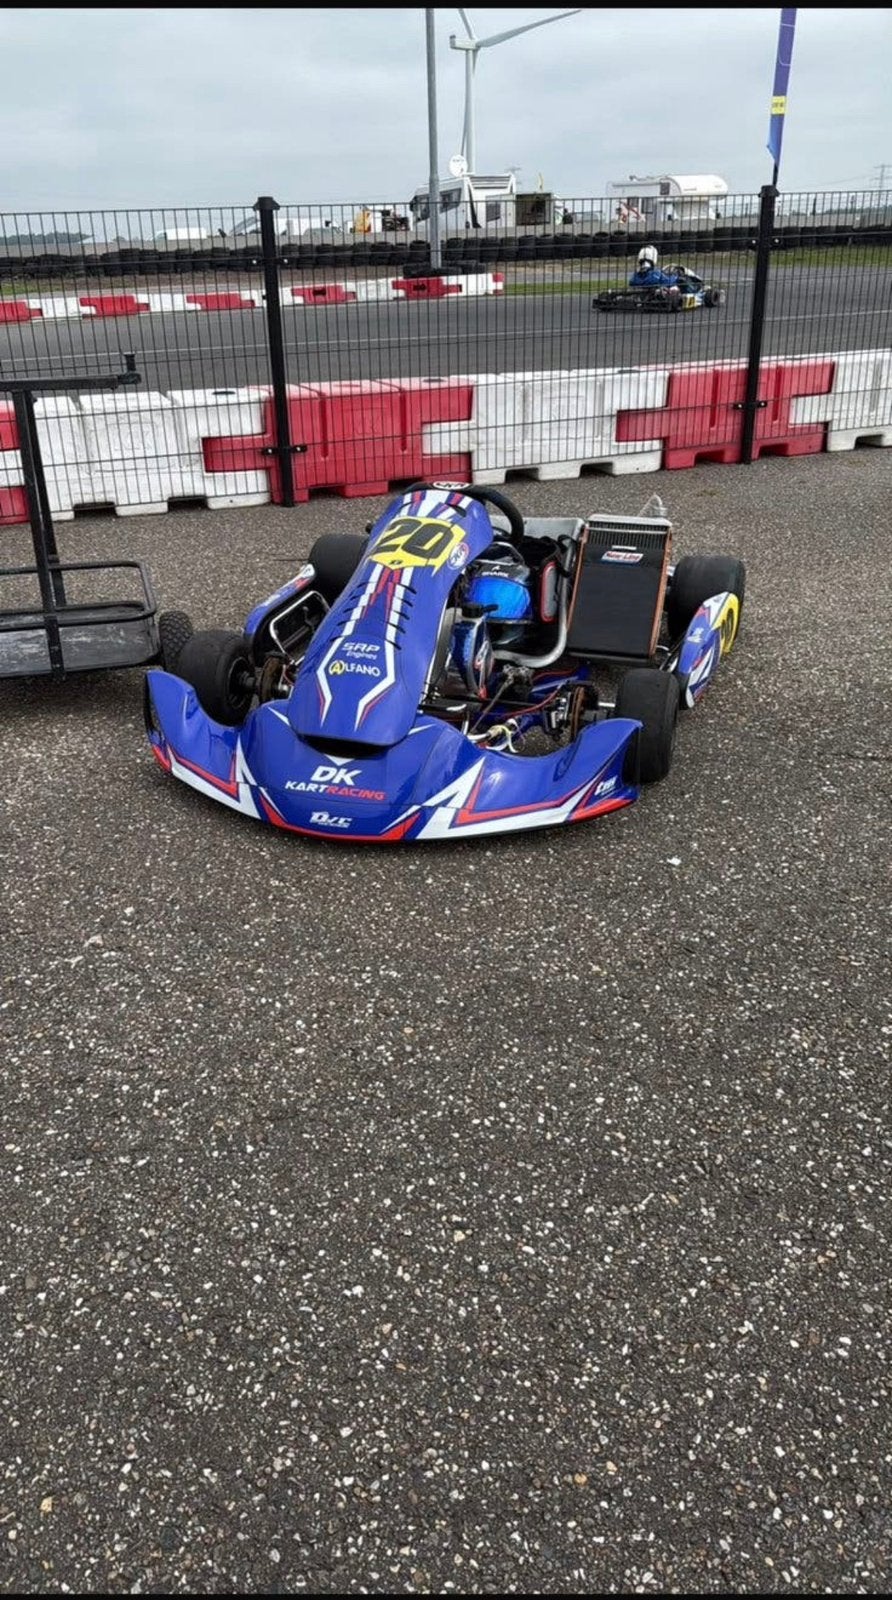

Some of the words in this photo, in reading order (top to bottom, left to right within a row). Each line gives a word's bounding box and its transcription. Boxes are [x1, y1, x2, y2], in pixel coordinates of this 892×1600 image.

[370, 519, 454, 559] 20
[328, 660, 381, 677] ALFANO
[310, 765, 362, 786] DK
